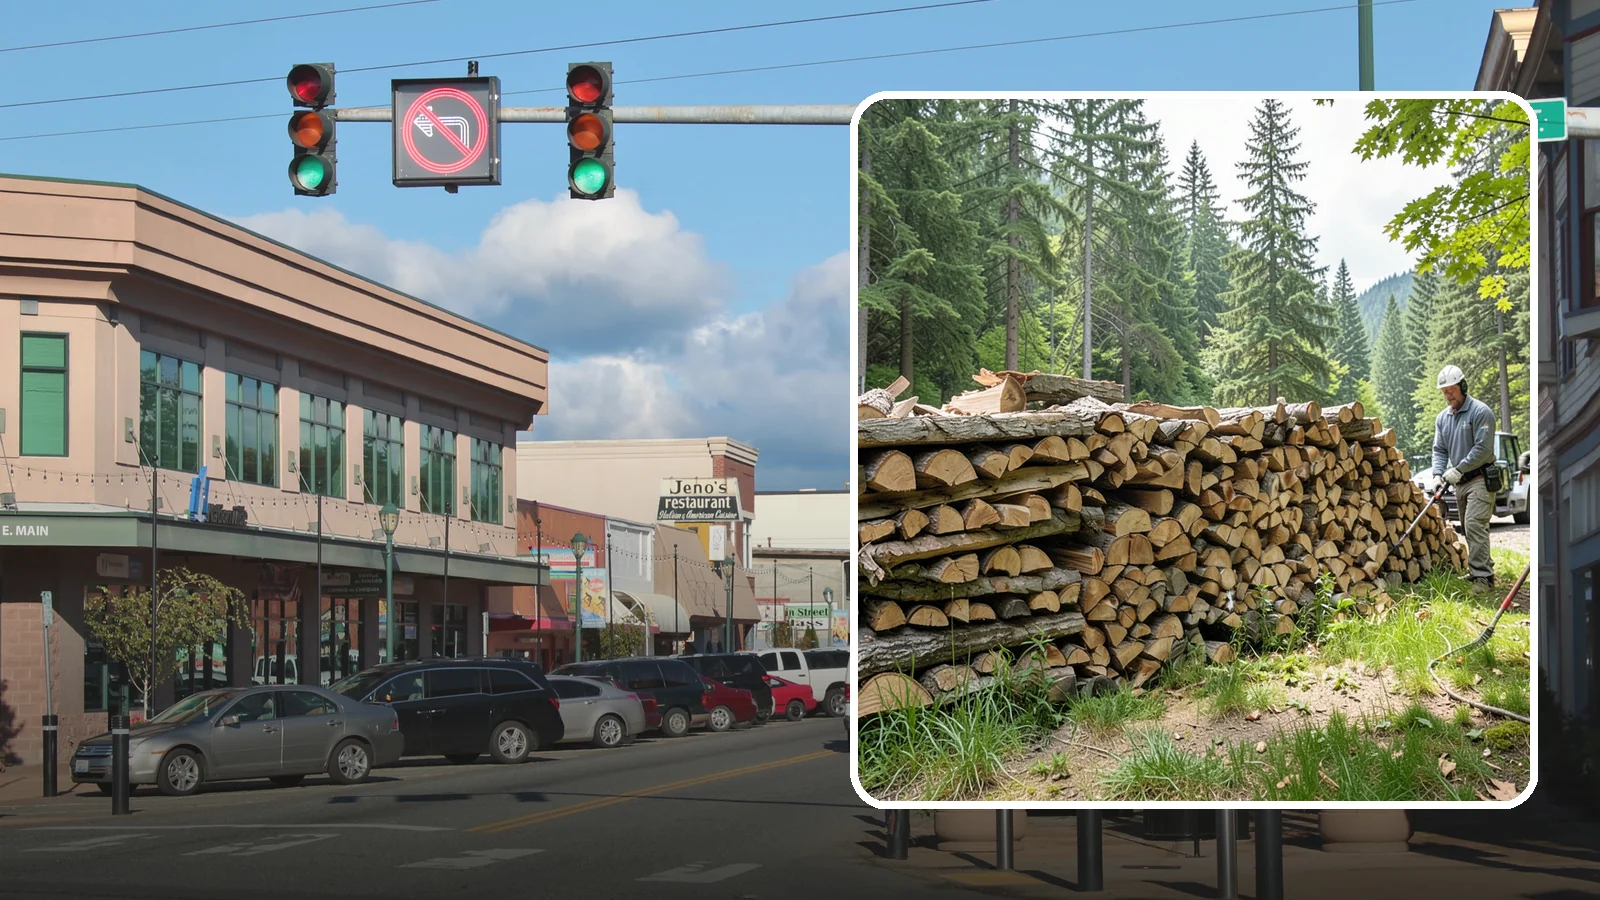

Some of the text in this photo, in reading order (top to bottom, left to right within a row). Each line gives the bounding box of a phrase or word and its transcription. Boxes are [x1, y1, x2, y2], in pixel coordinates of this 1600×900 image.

[670, 480, 727, 494] Jeno's
[665, 497, 731, 509] restaurant
[658, 509, 681, 519] Italian
[686, 509, 714, 519] American
[715, 509, 737, 519] Cuisine
[2, 525, 49, 536] E. MAIN
[797, 607, 828, 617] Street
